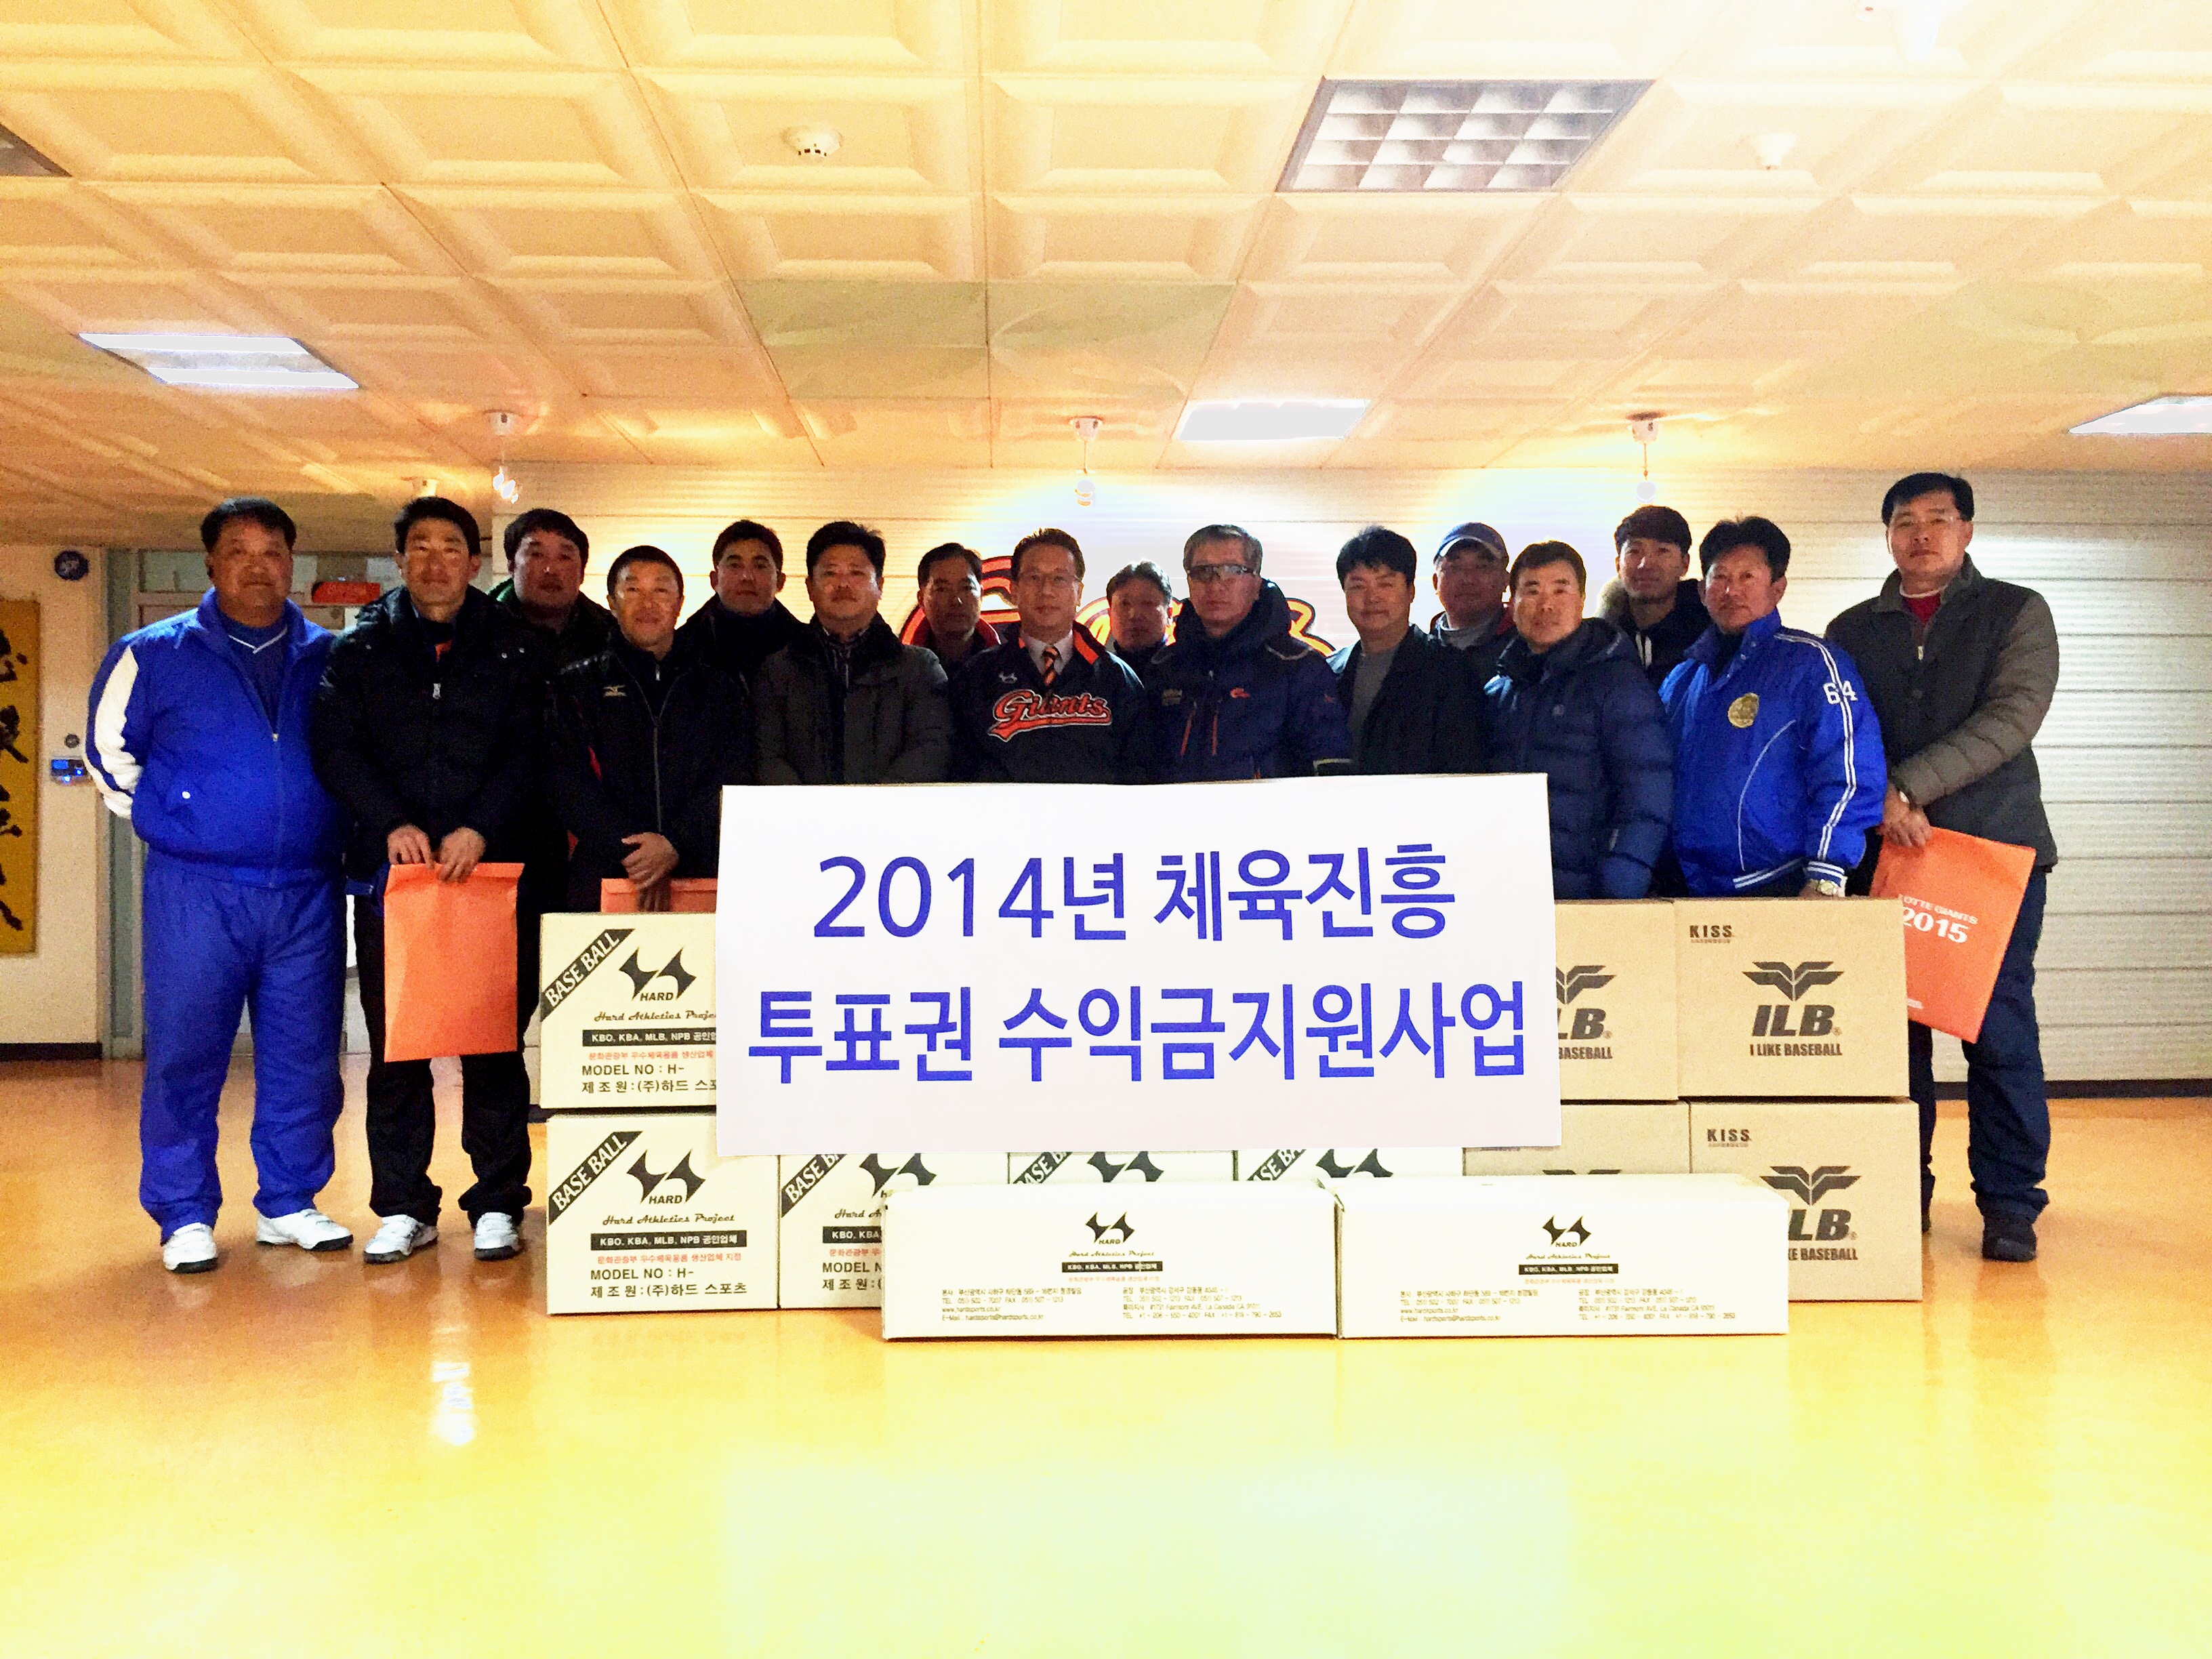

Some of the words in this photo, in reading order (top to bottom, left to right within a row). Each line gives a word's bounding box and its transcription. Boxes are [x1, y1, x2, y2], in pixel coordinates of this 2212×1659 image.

[1822, 680, 1858, 705] 64
[988, 689, 1112, 742] Giants
[813, 851, 1128, 941] 2014년
[1154, 843, 1456, 942] 체육진흥
[1934, 905, 1978, 925] GIANTS
[1689, 924, 1732, 938] KISS
[1903, 906, 1969, 943] 2015
[545, 965, 584, 1006] BASE
[580, 933, 619, 972] BALL
[640, 991, 674, 1001] HARD
[594, 1011, 625, 1021] Hard
[629, 1010, 681, 1021] Athletics
[1752, 1004, 1835, 1037] ILB
[671, 1031, 691, 1041] NPB
[747, 986, 972, 1084] 투표권
[998, 980, 1525, 1082] 수익금지원사업
[1749, 1044, 1755, 1056] I
[1757, 1043, 1782, 1056] LIKE
[1784, 1043, 1843, 1056] BASEBALL
[581, 1065, 630, 1076] MODEL
[634, 1064, 654, 1075] NO
[668, 1063, 684, 1074] H-
[1707, 1128, 1750, 1142] KISS
[552, 1167, 592, 1212] BASE
[587, 1134, 628, 1177] BALL
[785, 1160, 825, 1203] BASE
[649, 1195, 683, 1205] HARD
[602, 1214, 634, 1225] Hard
[637, 1214, 690, 1224] Athletics
[695, 1213, 735, 1224] Project
[834, 1208, 865, 1218] Hard
[680, 1235, 700, 1244] NPB
[1800, 1248, 1858, 1261] BASEBALL
[590, 1269, 638, 1280] MODEL
[644, 1268, 663, 1279] NO
[677, 1267, 694, 1278] H-
[822, 1262, 870, 1273] MODEL
[704, 1282, 747, 1294] 스포츠
